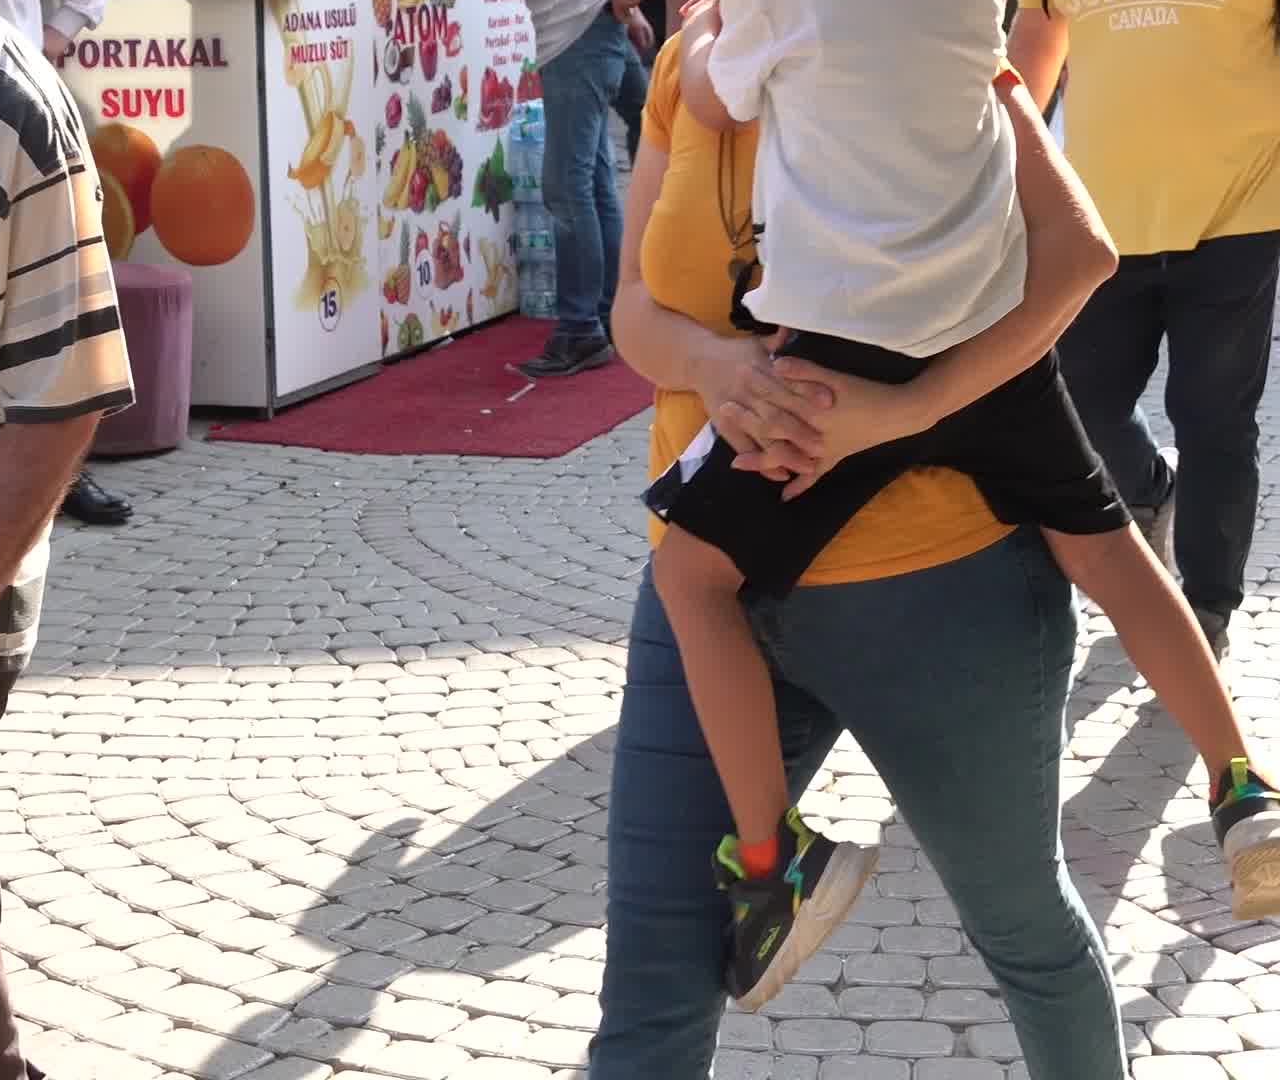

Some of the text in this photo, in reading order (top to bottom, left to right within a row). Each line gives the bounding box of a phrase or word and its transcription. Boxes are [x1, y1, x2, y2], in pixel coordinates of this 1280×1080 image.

[283, 9, 323, 33] ADANA
[394, 3, 449, 44] ATOM
[1109, 7, 1180, 32] CANADA
[56, 37, 228, 68] PORTAKAL
[290, 35, 349, 65] MUZLU SÜT
[101, 87, 186, 118] SUYU
[418, 261, 432, 286] 10
[322, 290, 338, 318] 15
